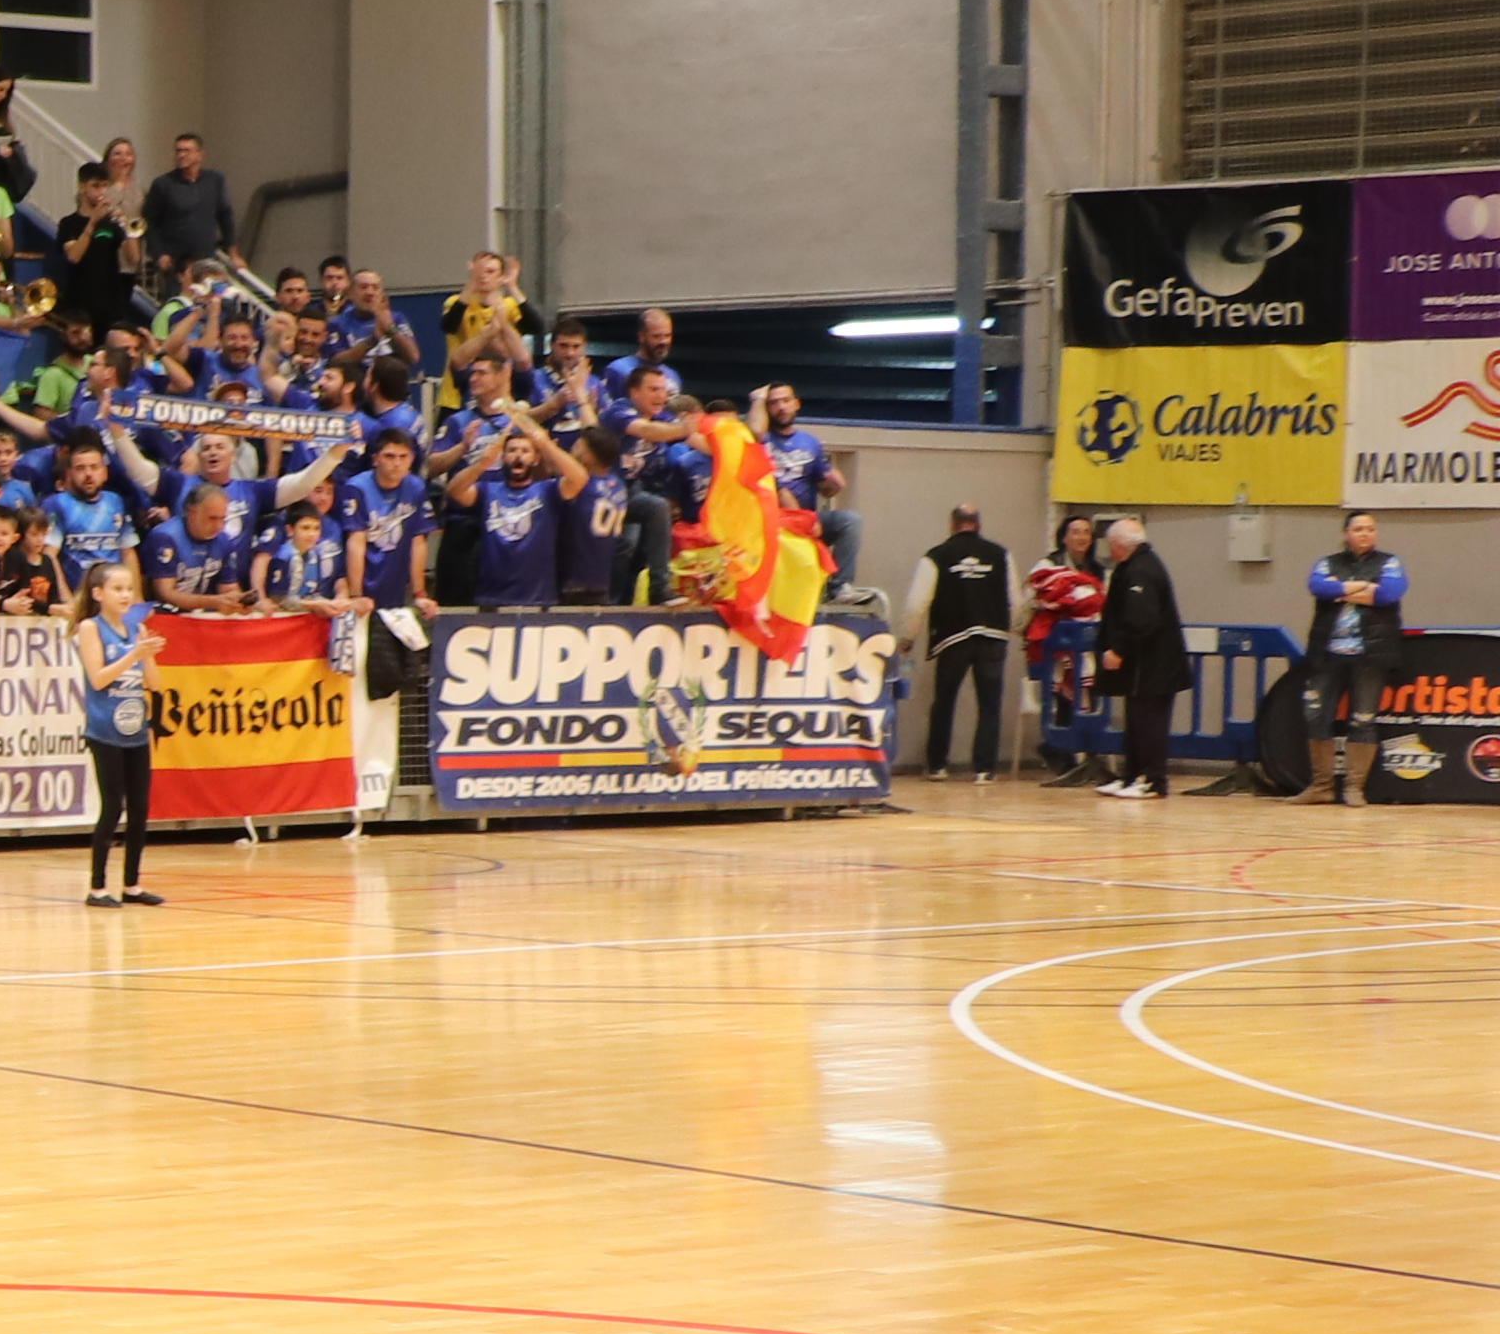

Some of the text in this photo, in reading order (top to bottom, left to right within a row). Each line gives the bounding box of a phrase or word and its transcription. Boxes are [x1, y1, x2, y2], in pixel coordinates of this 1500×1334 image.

[1382, 251, 1500, 273] JOSE ANT
[1152, 391, 1338, 437] Calabrús
[1156, 443, 1222, 462] VIAJES
[439, 622, 897, 706] SUPPORTERS
[145, 679, 346, 750] Peñíscola
[456, 714, 629, 747] FONDO
[37, 770, 75, 812] 00
[456, 776, 534, 800] DESDE
[534, 774, 591, 797] 2006
[591, 773, 624, 796] AL
[623, 771, 687, 795] LADO
[685, 770, 733, 793] DEL
